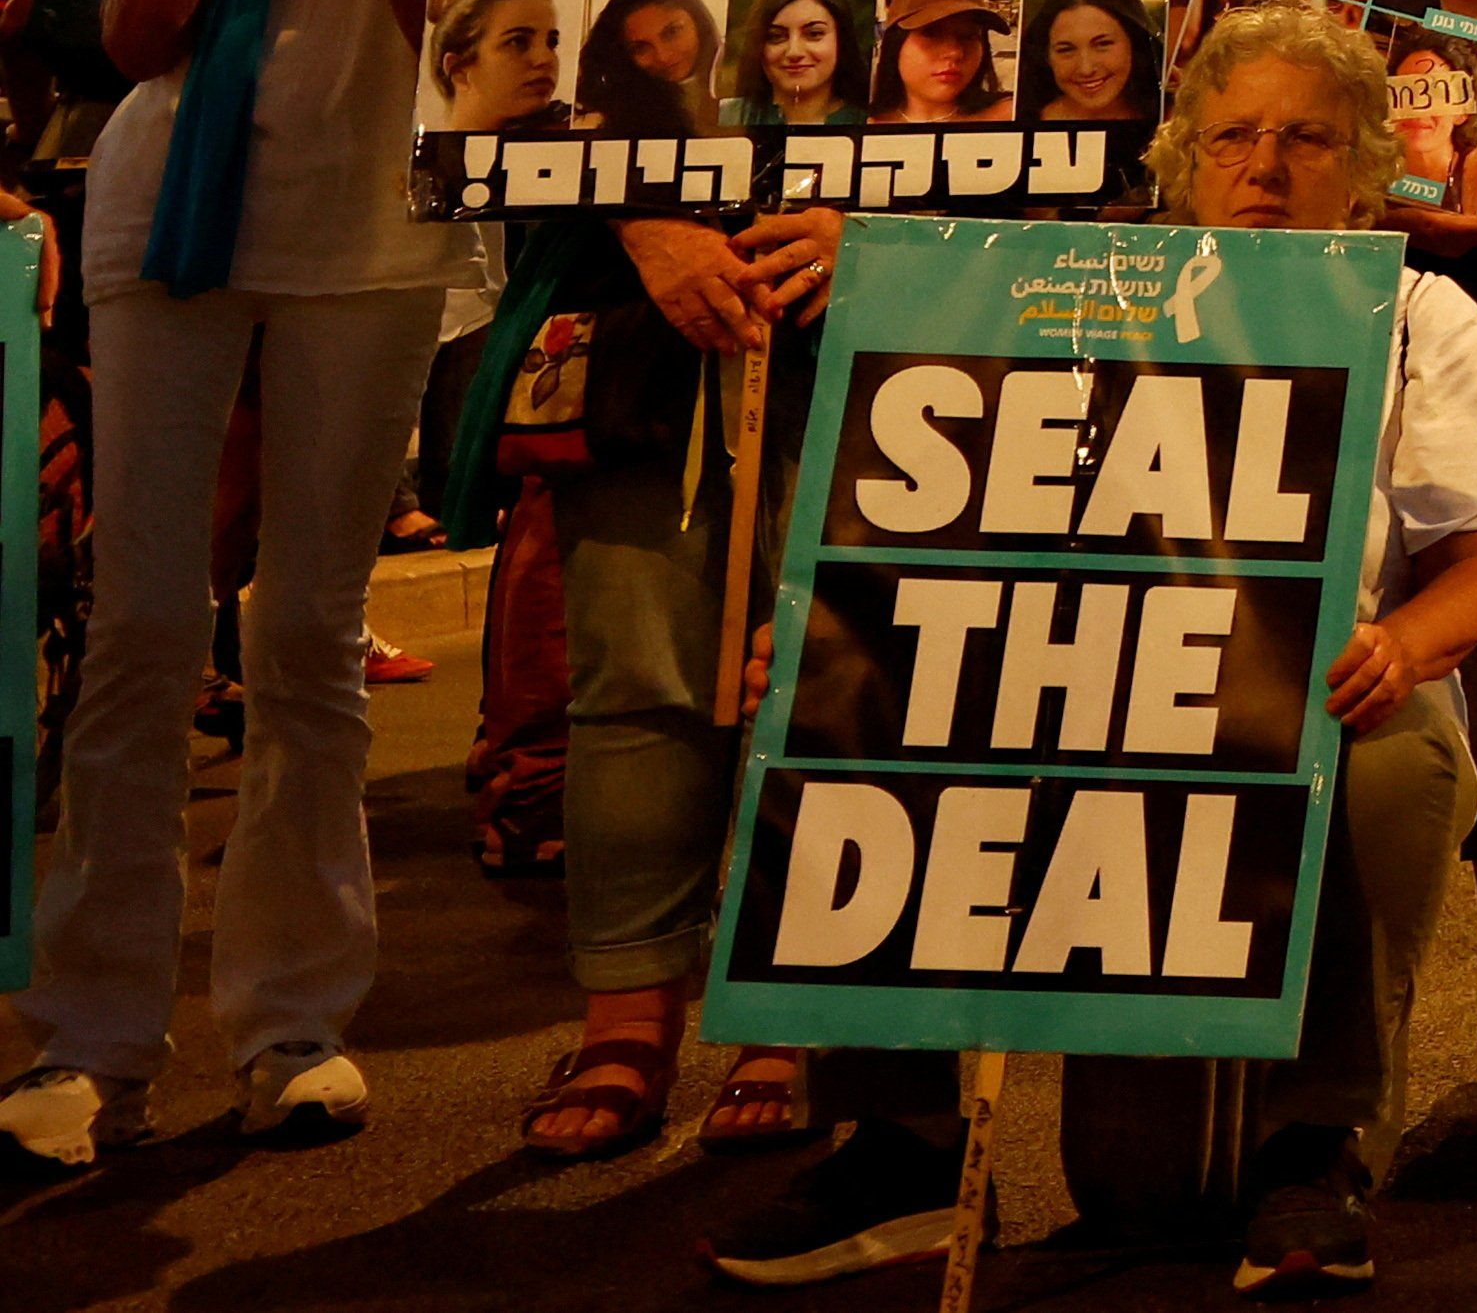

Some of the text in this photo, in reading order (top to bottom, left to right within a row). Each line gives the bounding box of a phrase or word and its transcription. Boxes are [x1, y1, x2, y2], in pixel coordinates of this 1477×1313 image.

[1432, 13, 1455, 33] גונן
[462, 132, 1106, 208] עסקה היום!
[1114, 254, 1166, 272] נשים
[855, 363, 1313, 543] SEAL
[892, 578, 1238, 756] THE
[772, 782, 1254, 979] DEAL
